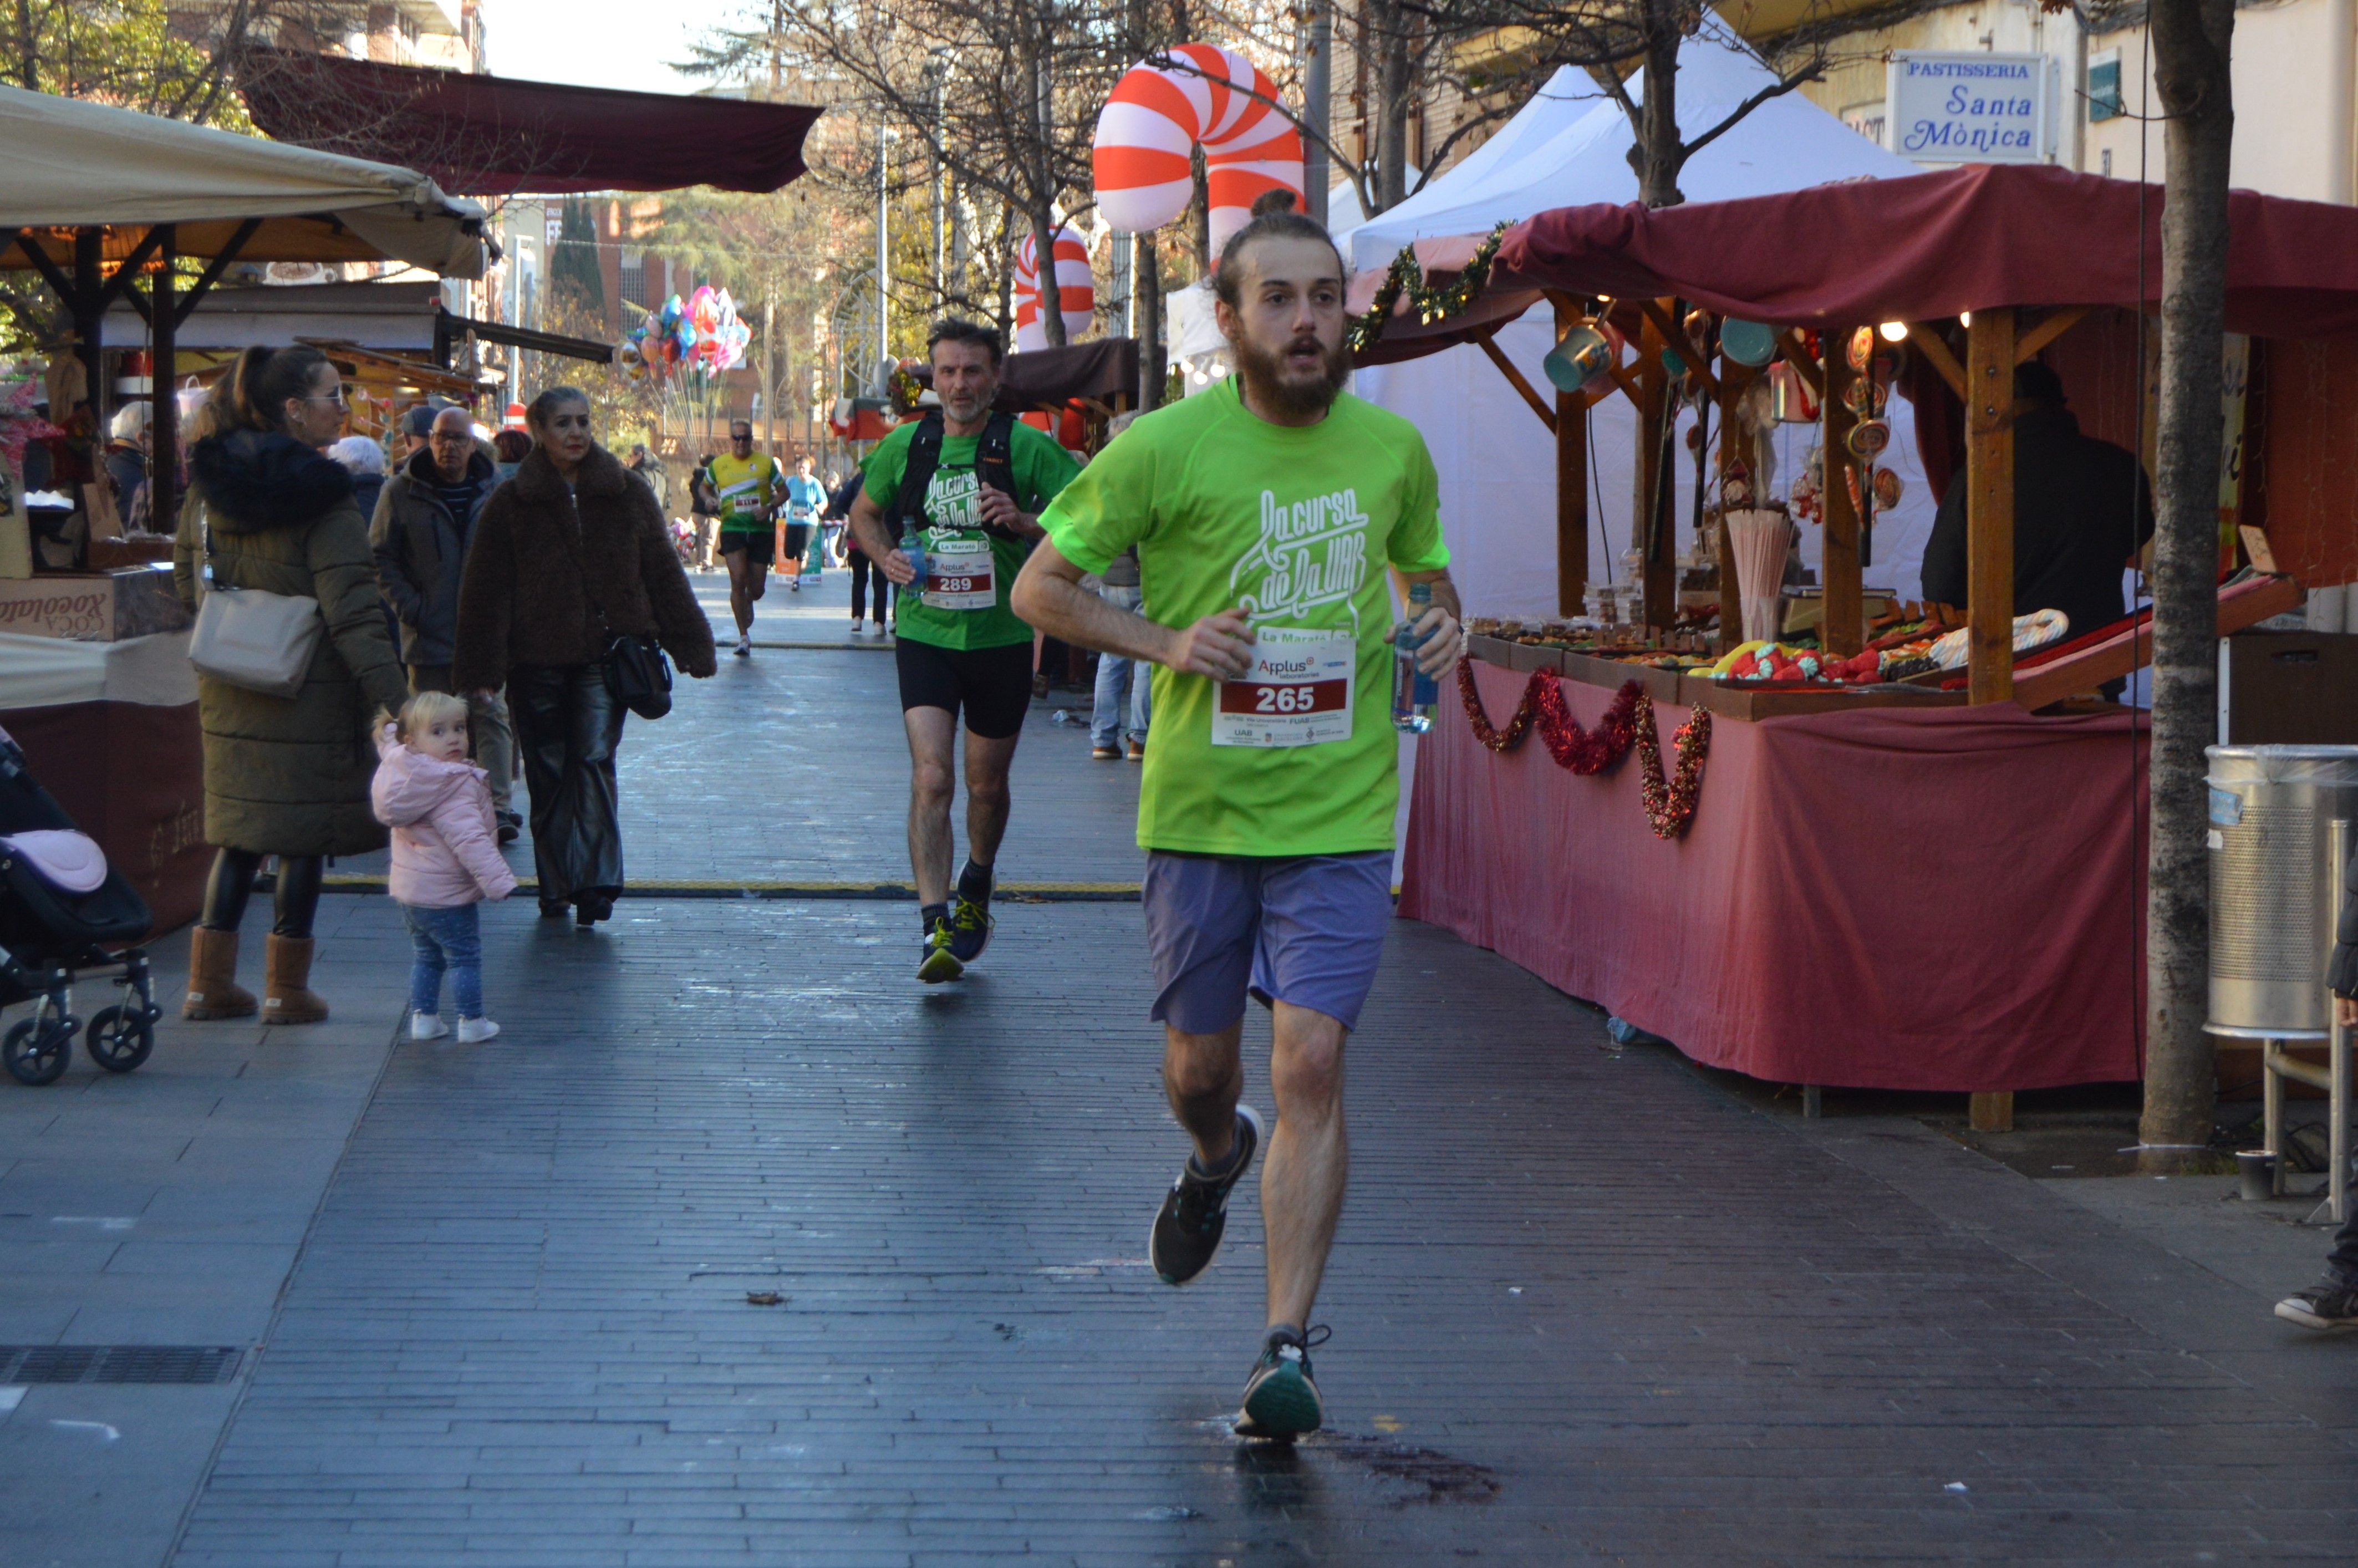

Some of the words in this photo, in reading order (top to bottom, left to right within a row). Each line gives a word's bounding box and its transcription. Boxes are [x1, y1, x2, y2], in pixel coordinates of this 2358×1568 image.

[1908, 62, 2029, 78] PASTISSERIA
[1946, 84, 2031, 115] Santa
[1904, 119, 2031, 152] Mònica
[940, 578, 971, 591] 289
[1260, 571, 1290, 609] de
[45, 615, 105, 632] COCA
[1256, 686, 1314, 712] 265
